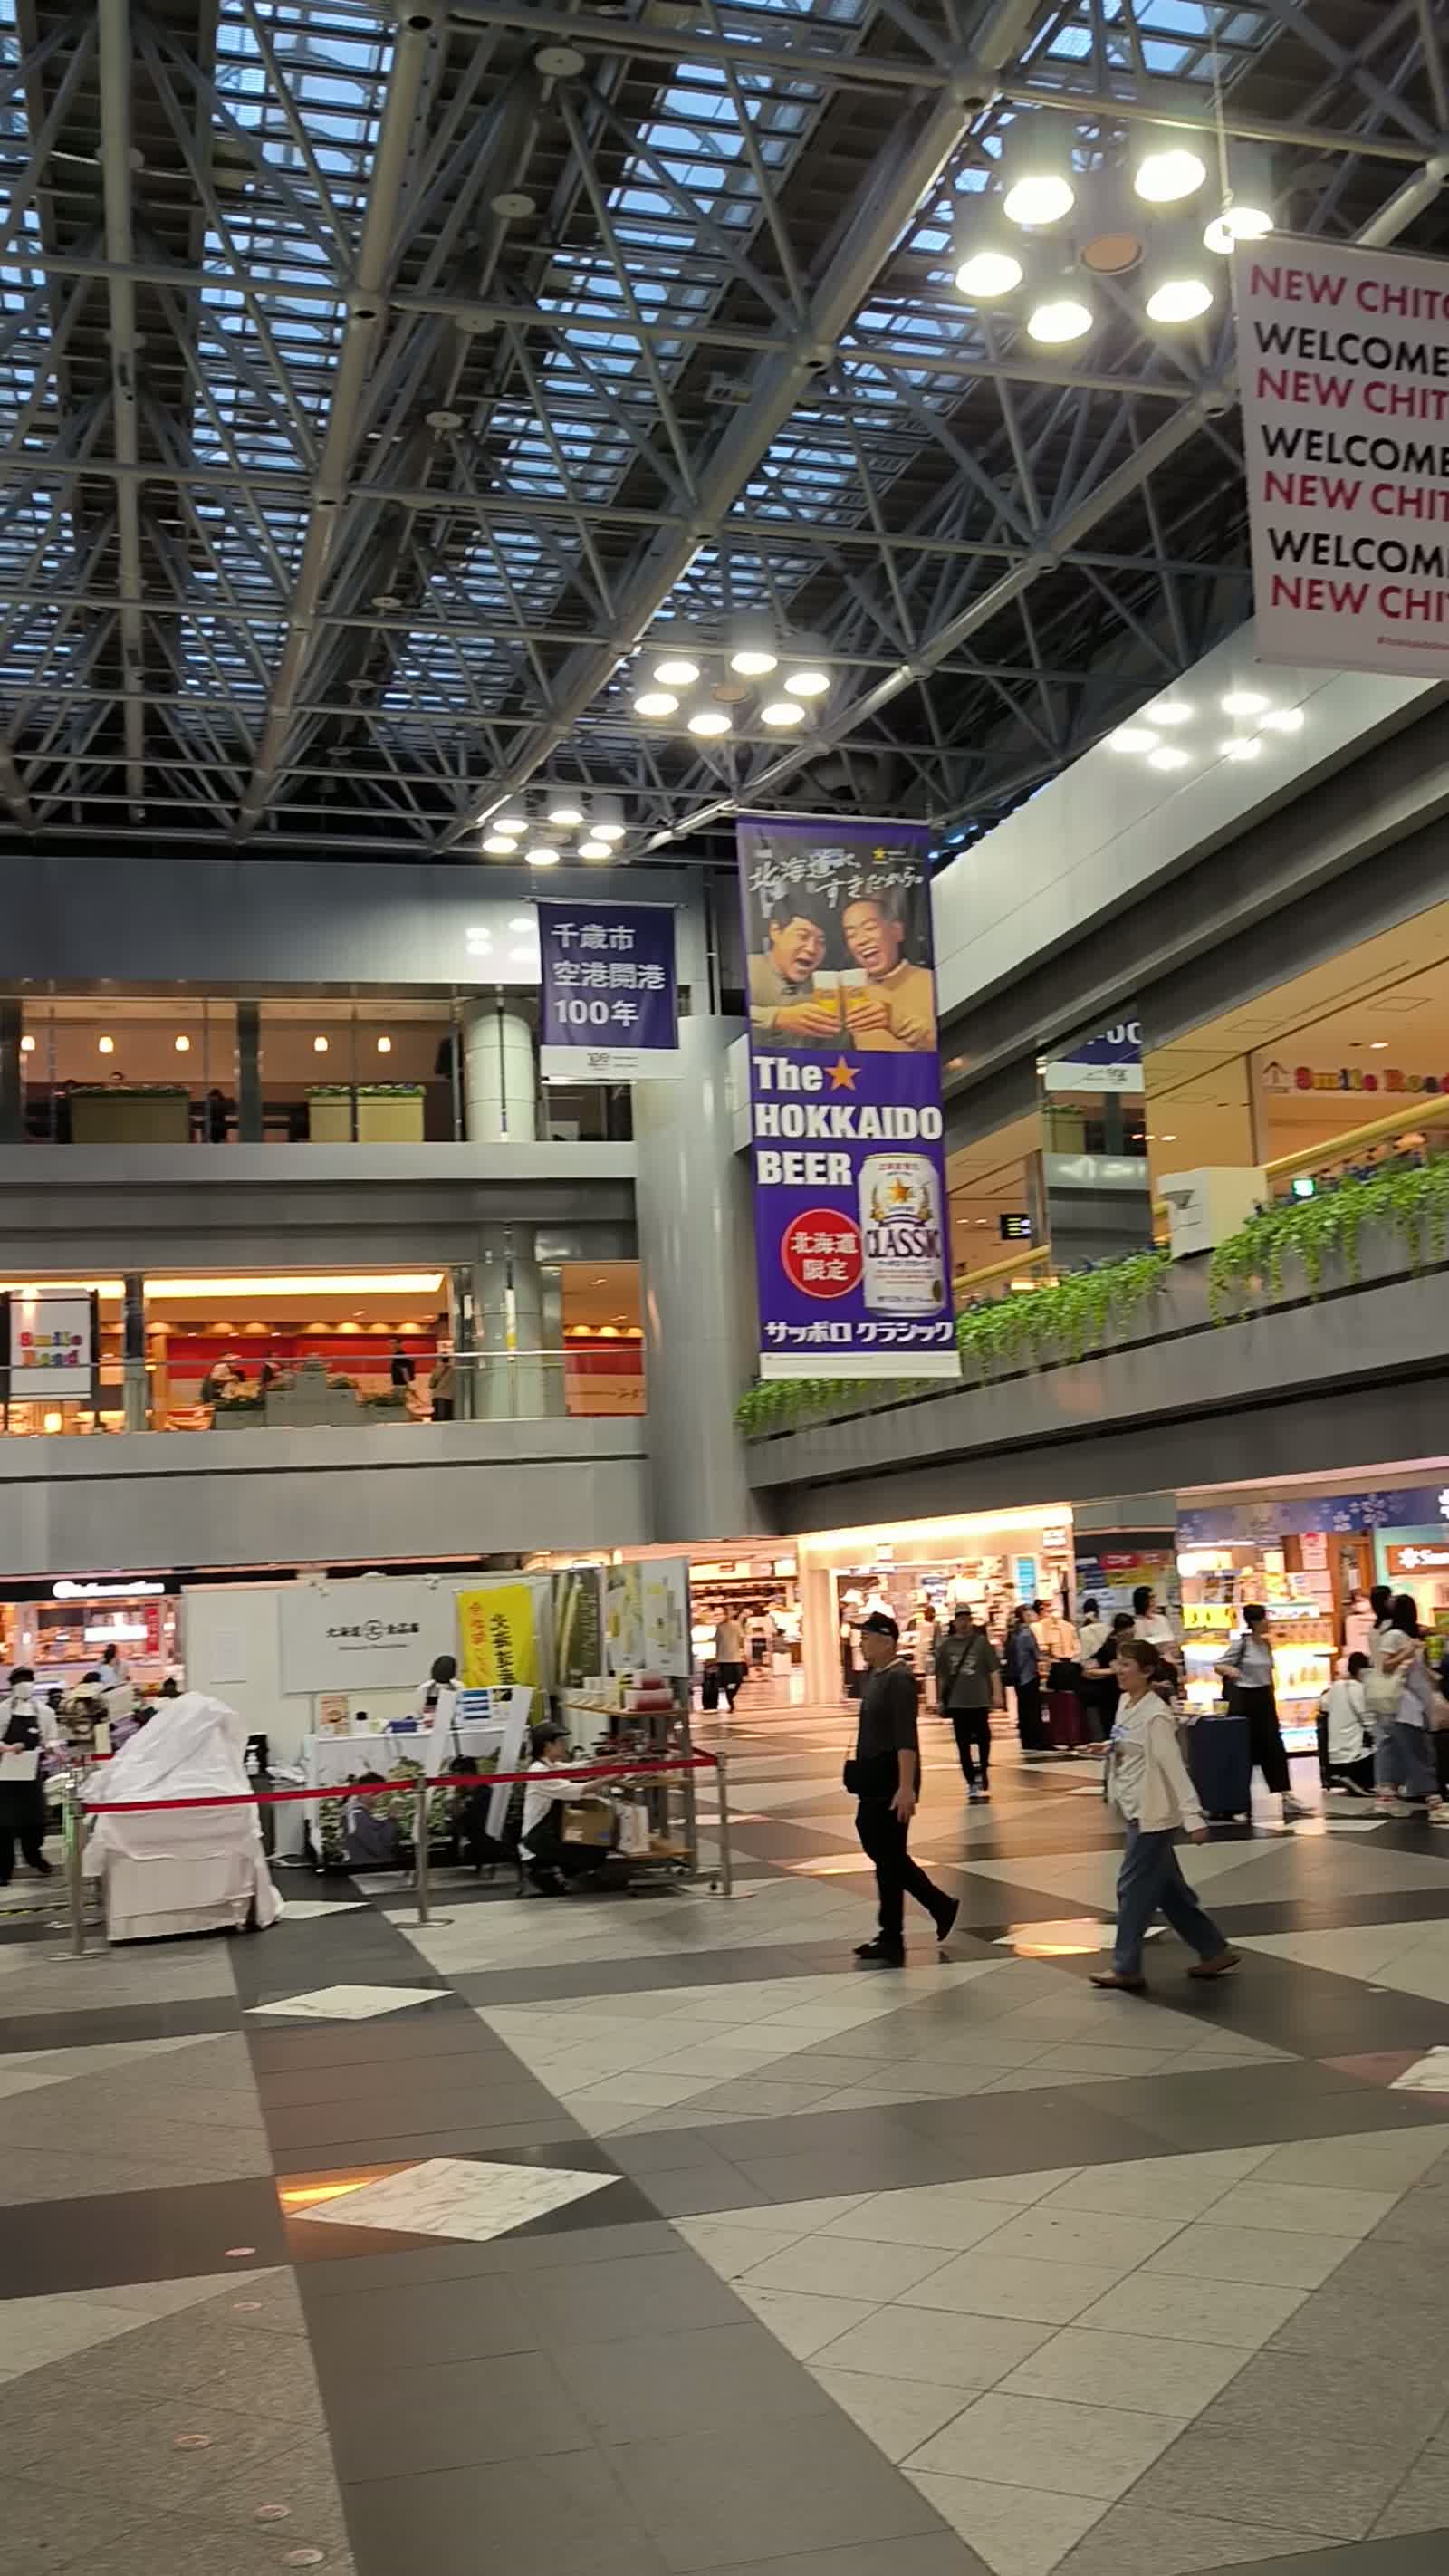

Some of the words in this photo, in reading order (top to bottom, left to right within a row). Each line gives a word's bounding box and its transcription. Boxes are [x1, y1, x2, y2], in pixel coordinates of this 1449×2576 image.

[1251, 264, 1348, 306] NEW
[1356, 280, 1449, 320] CHIT
[1254, 322, 1449, 377] WELCOME
[1257, 367, 1354, 409] NEW
[1364, 380, 1449, 421] CHIT
[1264, 470, 1362, 511] NEW
[1268, 527, 1449, 578] WELCOM
[1271, 574, 1369, 615] NEW
[1378, 585, 1449, 622] CHI
[551, 922, 636, 951] 千歳市
[552, 960, 666, 990] 空港開港
[554, 999, 639, 1027] 100年
[753, 1055, 823, 1091] The
[754, 1102, 943, 1140] HOKKAIDO
[756, 1150, 853, 1186] BEER
[790, 1231, 859, 1254] 北海道
[802, 1260, 849, 1282] 限定
[764, 1321, 853, 1343] サッポロ
[857, 1322, 953, 1343] クラシック
